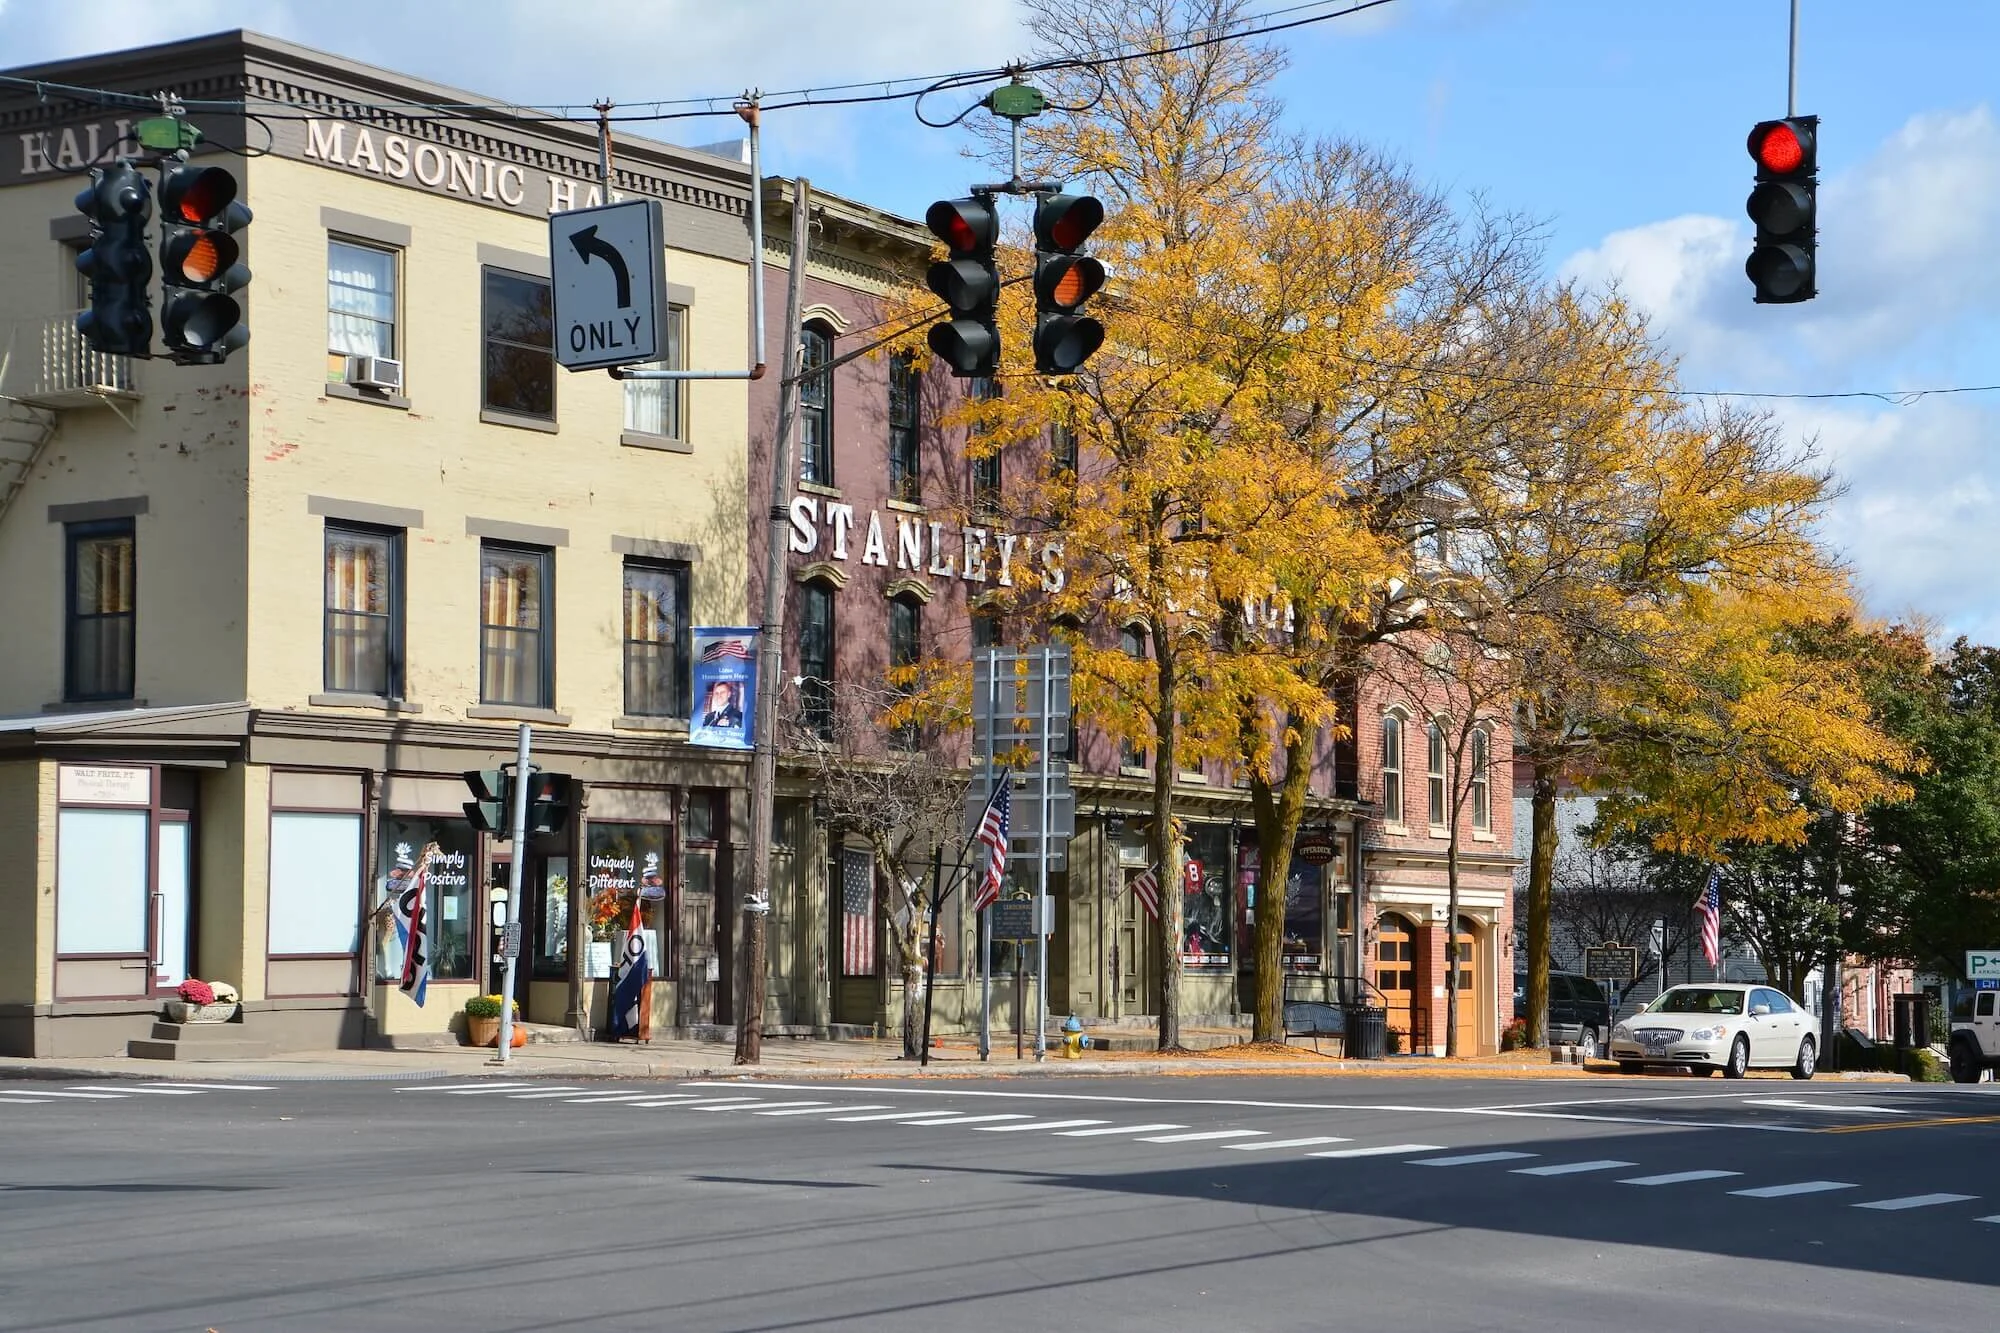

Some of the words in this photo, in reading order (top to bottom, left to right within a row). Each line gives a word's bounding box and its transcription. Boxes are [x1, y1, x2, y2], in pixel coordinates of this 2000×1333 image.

[20, 119, 145, 174] HALL
[304, 118, 525, 206] MASONIC
[569, 316, 642, 353] ONLY
[788, 496, 1066, 594] STANLEY'S
[425, 850, 465, 869] Simply
[590, 855, 635, 873] Uniquely
[424, 870, 466, 886] Positive
[589, 874, 636, 889] Different
[1971, 955, 1987, 974] P
